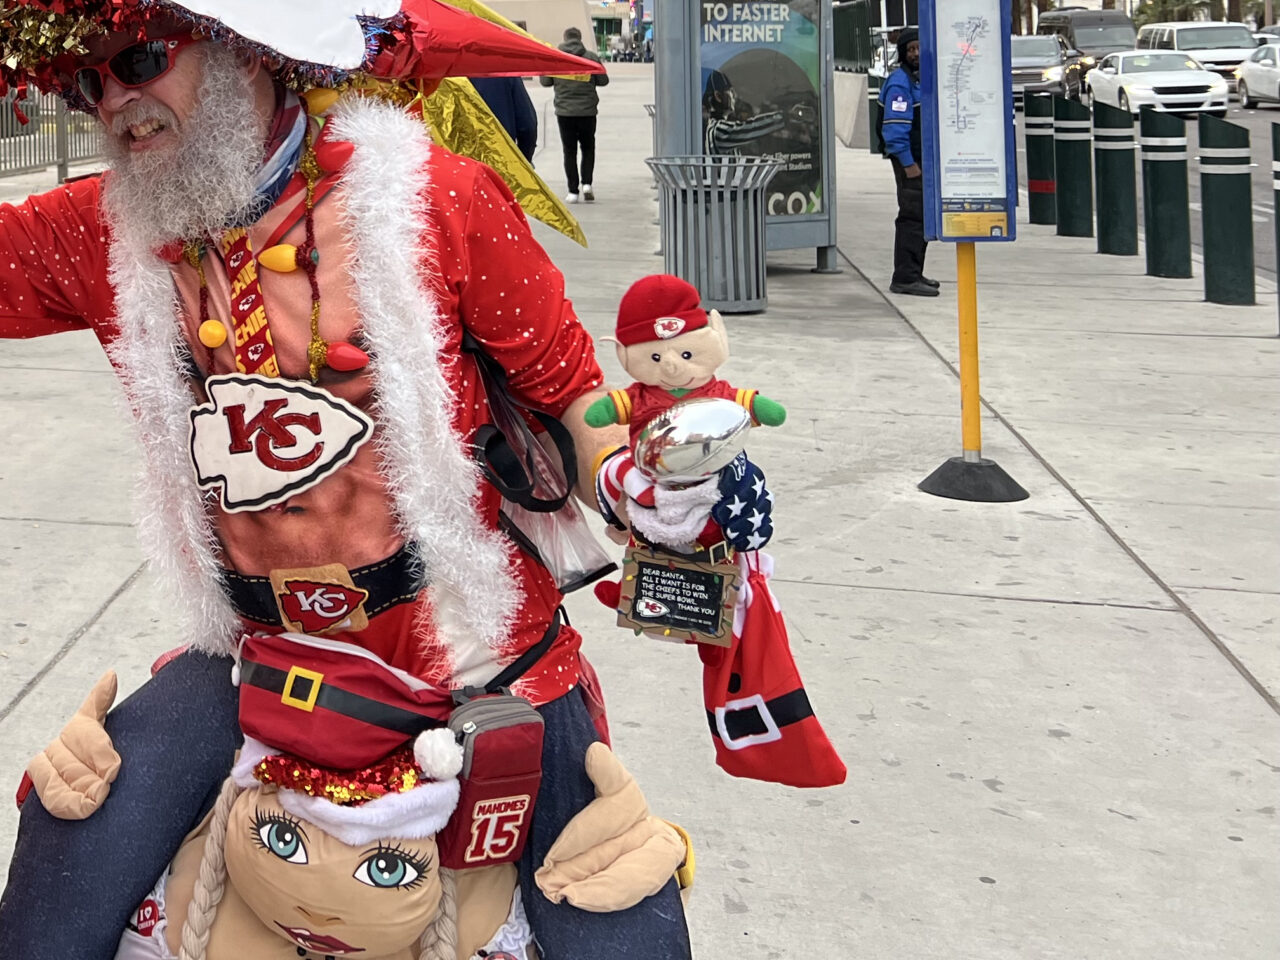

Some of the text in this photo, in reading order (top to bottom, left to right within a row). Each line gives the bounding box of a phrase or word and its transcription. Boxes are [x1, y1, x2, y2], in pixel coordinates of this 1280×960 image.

[703, 3, 790, 21] TO FASTER
[704, 24, 784, 42] INTERNET
[790, 152, 812, 161] powers
[789, 162, 812, 170] Stadium
[768, 185, 822, 215] COX
[222, 397, 325, 473] KC
[642, 567, 660, 577] DEAR
[642, 575, 654, 583] ALL
[660, 578, 681, 587] WANT
[691, 583, 705, 591] FOR
[642, 582, 655, 590] THE
[655, 585, 680, 594] CHIEFS
[692, 591, 709, 600] WIN
[294, 587, 348, 618] KC
[641, 589, 654, 597] THE
[655, 592, 676, 601] SUPER
[677, 602, 716, 616] THANK YOU
[476, 799, 527, 817] MAHOMES
[468, 813, 522, 858] 15
[140, 909, 144, 922] I
